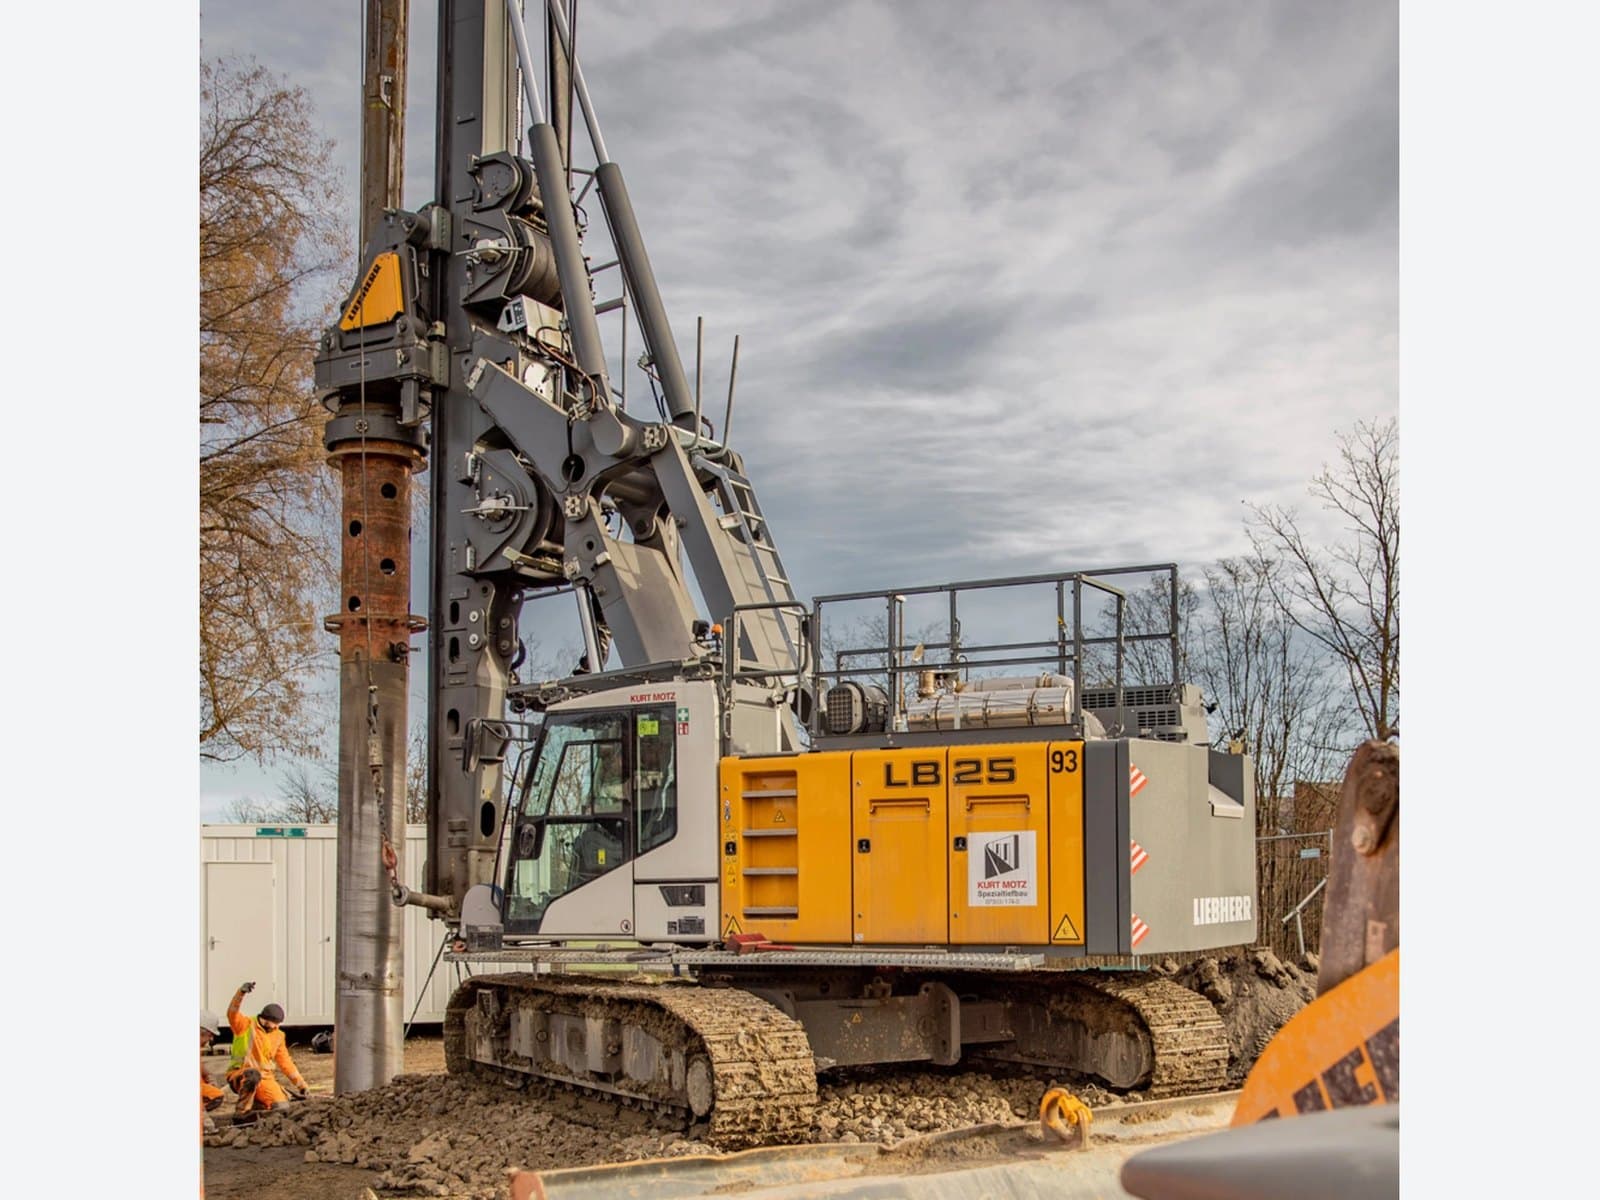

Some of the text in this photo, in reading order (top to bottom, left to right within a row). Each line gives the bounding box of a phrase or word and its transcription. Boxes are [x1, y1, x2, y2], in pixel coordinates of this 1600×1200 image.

[630, 692, 676, 703] KURT MOTZ
[1051, 750, 1078, 774] 93
[884, 757, 1016, 788] LB 25
[977, 880, 1027, 889] KURT MOTZ
[977, 889, 1028, 899] Spezialtiefbau
[1193, 895, 1252, 926] LIEBHERR
